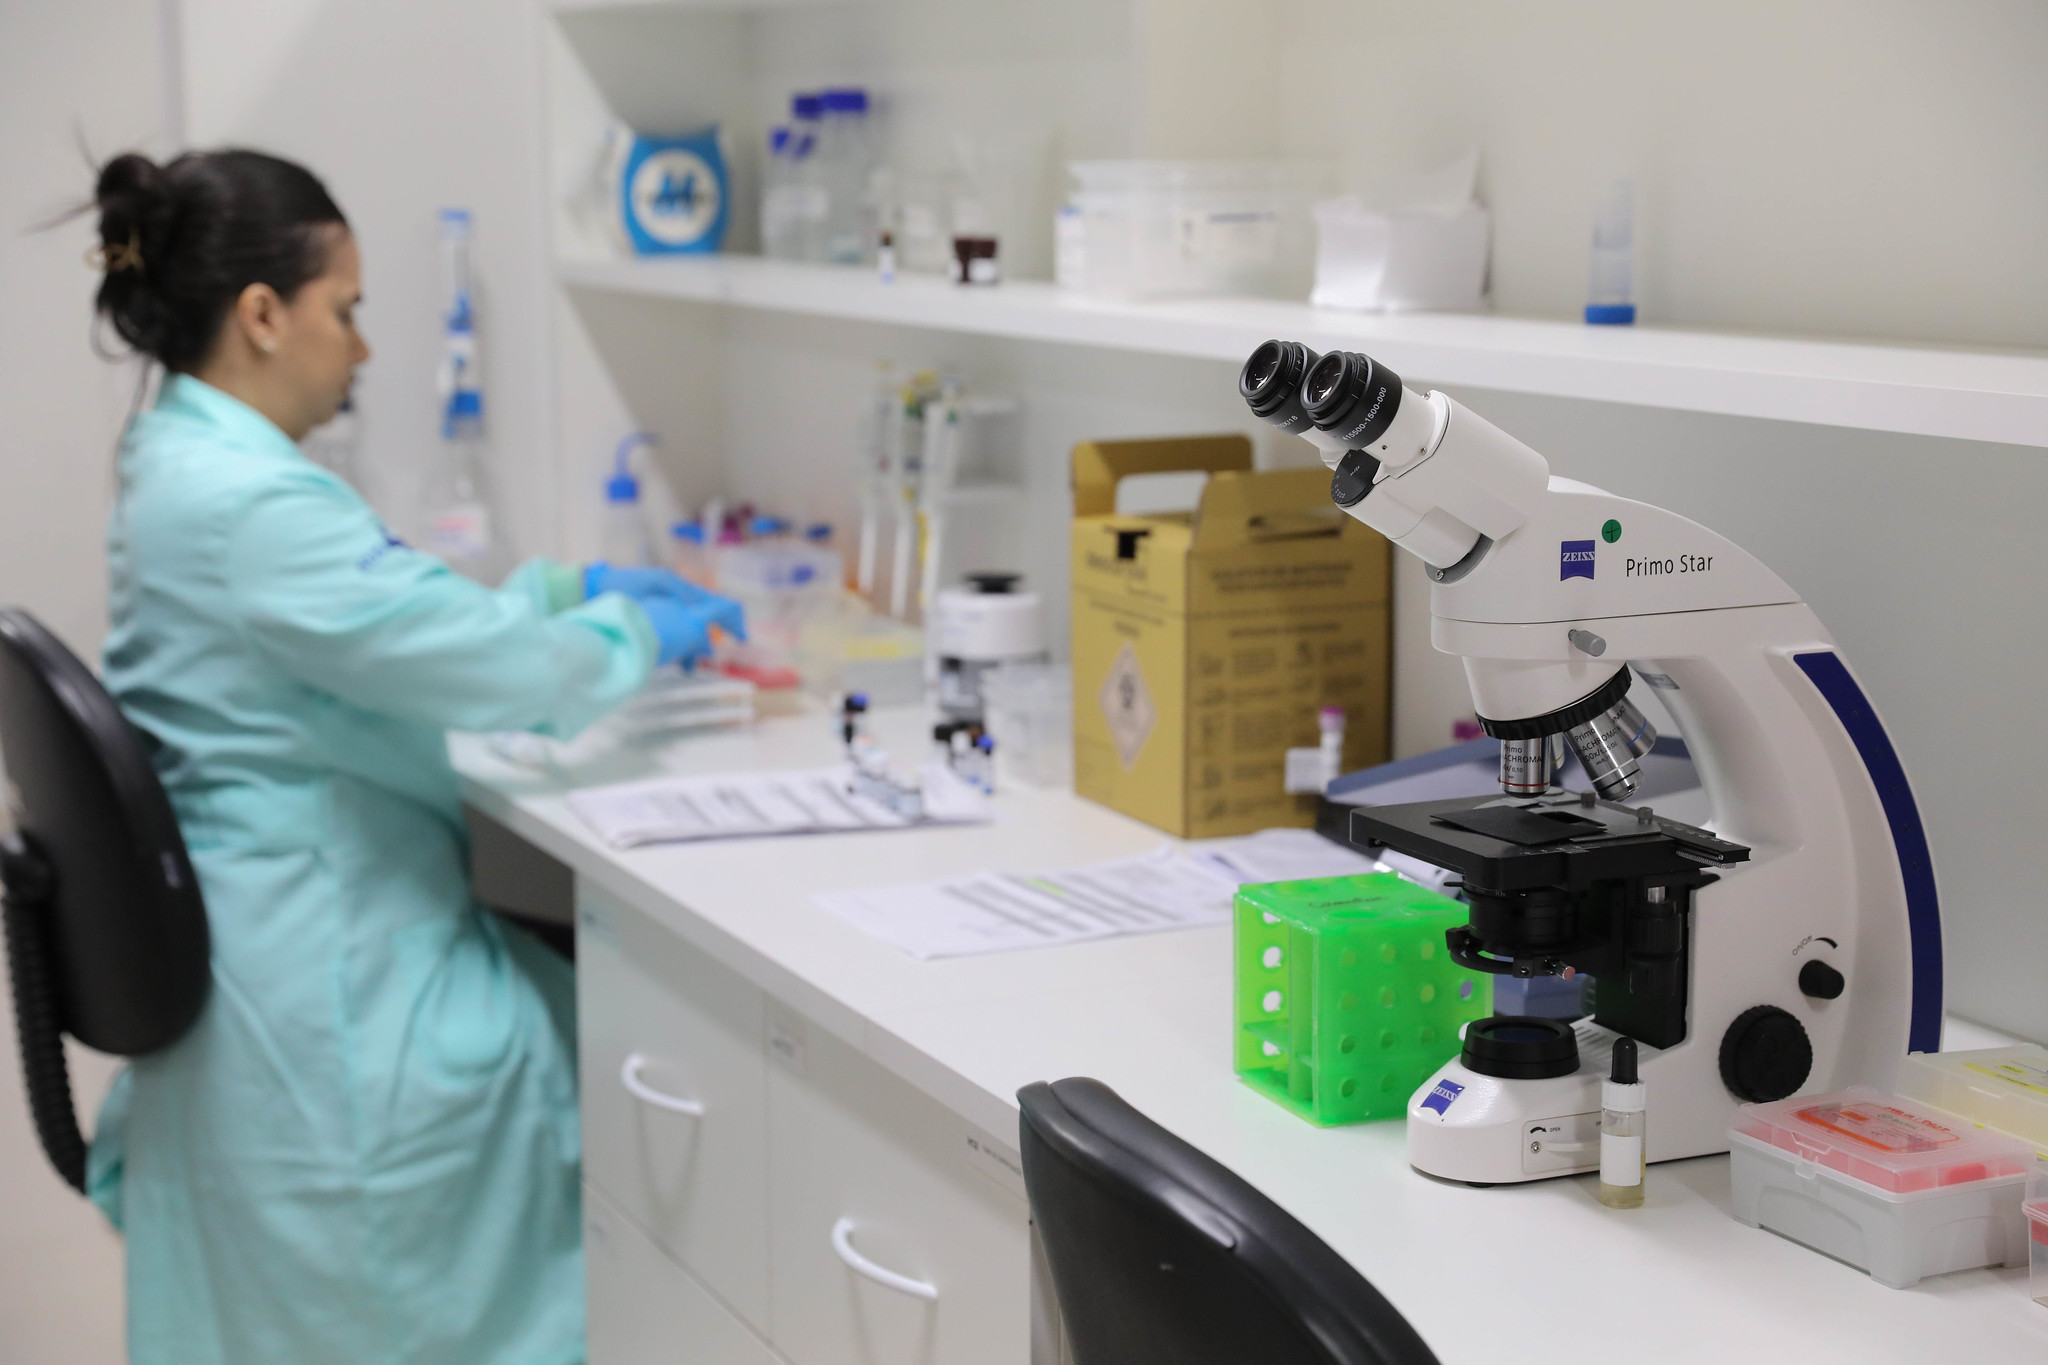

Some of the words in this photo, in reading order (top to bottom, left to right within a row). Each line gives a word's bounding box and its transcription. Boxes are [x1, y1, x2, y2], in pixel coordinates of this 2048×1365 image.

[1562, 551, 1595, 562] ZEISS
[1626, 557, 1674, 577] Primo
[1680, 554, 1713, 573] Star
[1433, 1086, 1458, 1102] ZEISS
